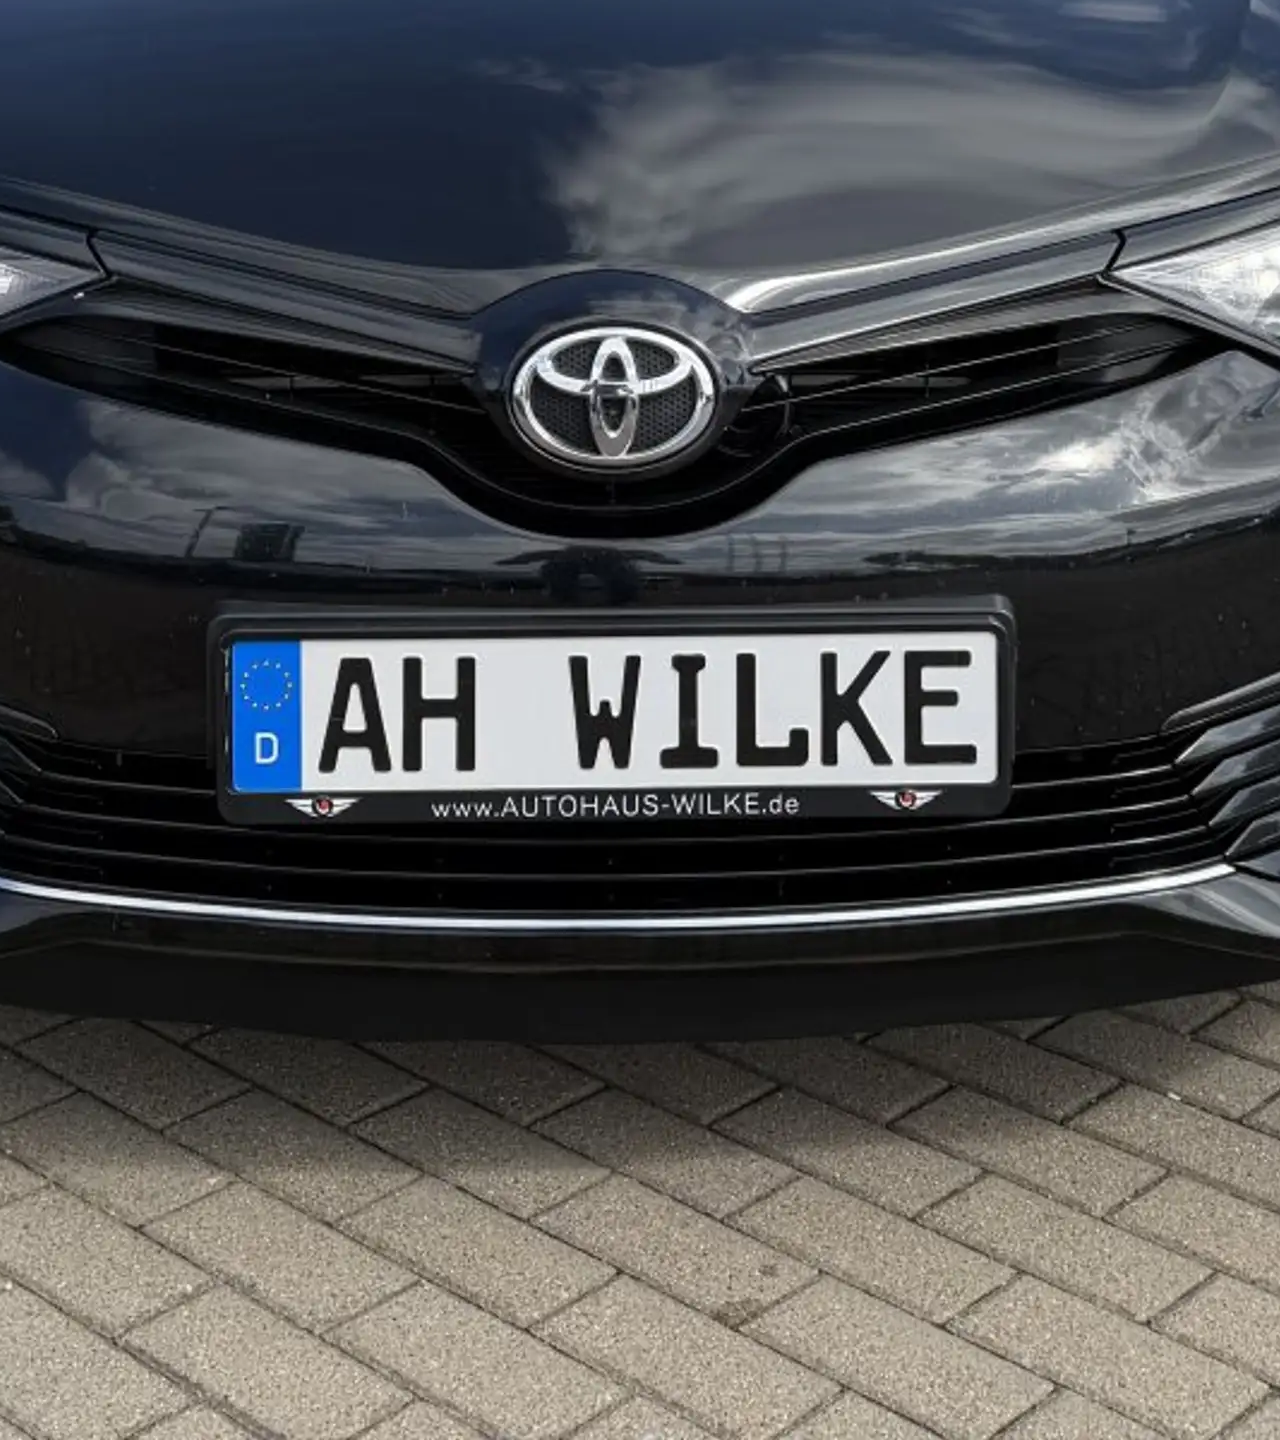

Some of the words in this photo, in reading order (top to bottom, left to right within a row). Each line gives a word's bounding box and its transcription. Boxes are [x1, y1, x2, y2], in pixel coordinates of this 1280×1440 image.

[318, 655, 476, 773] AH
[568, 650, 977, 770] WILKE
[255, 732, 279, 764] D
[431, 792, 800, 818] www.AUTOHAUS-WILKE.de
